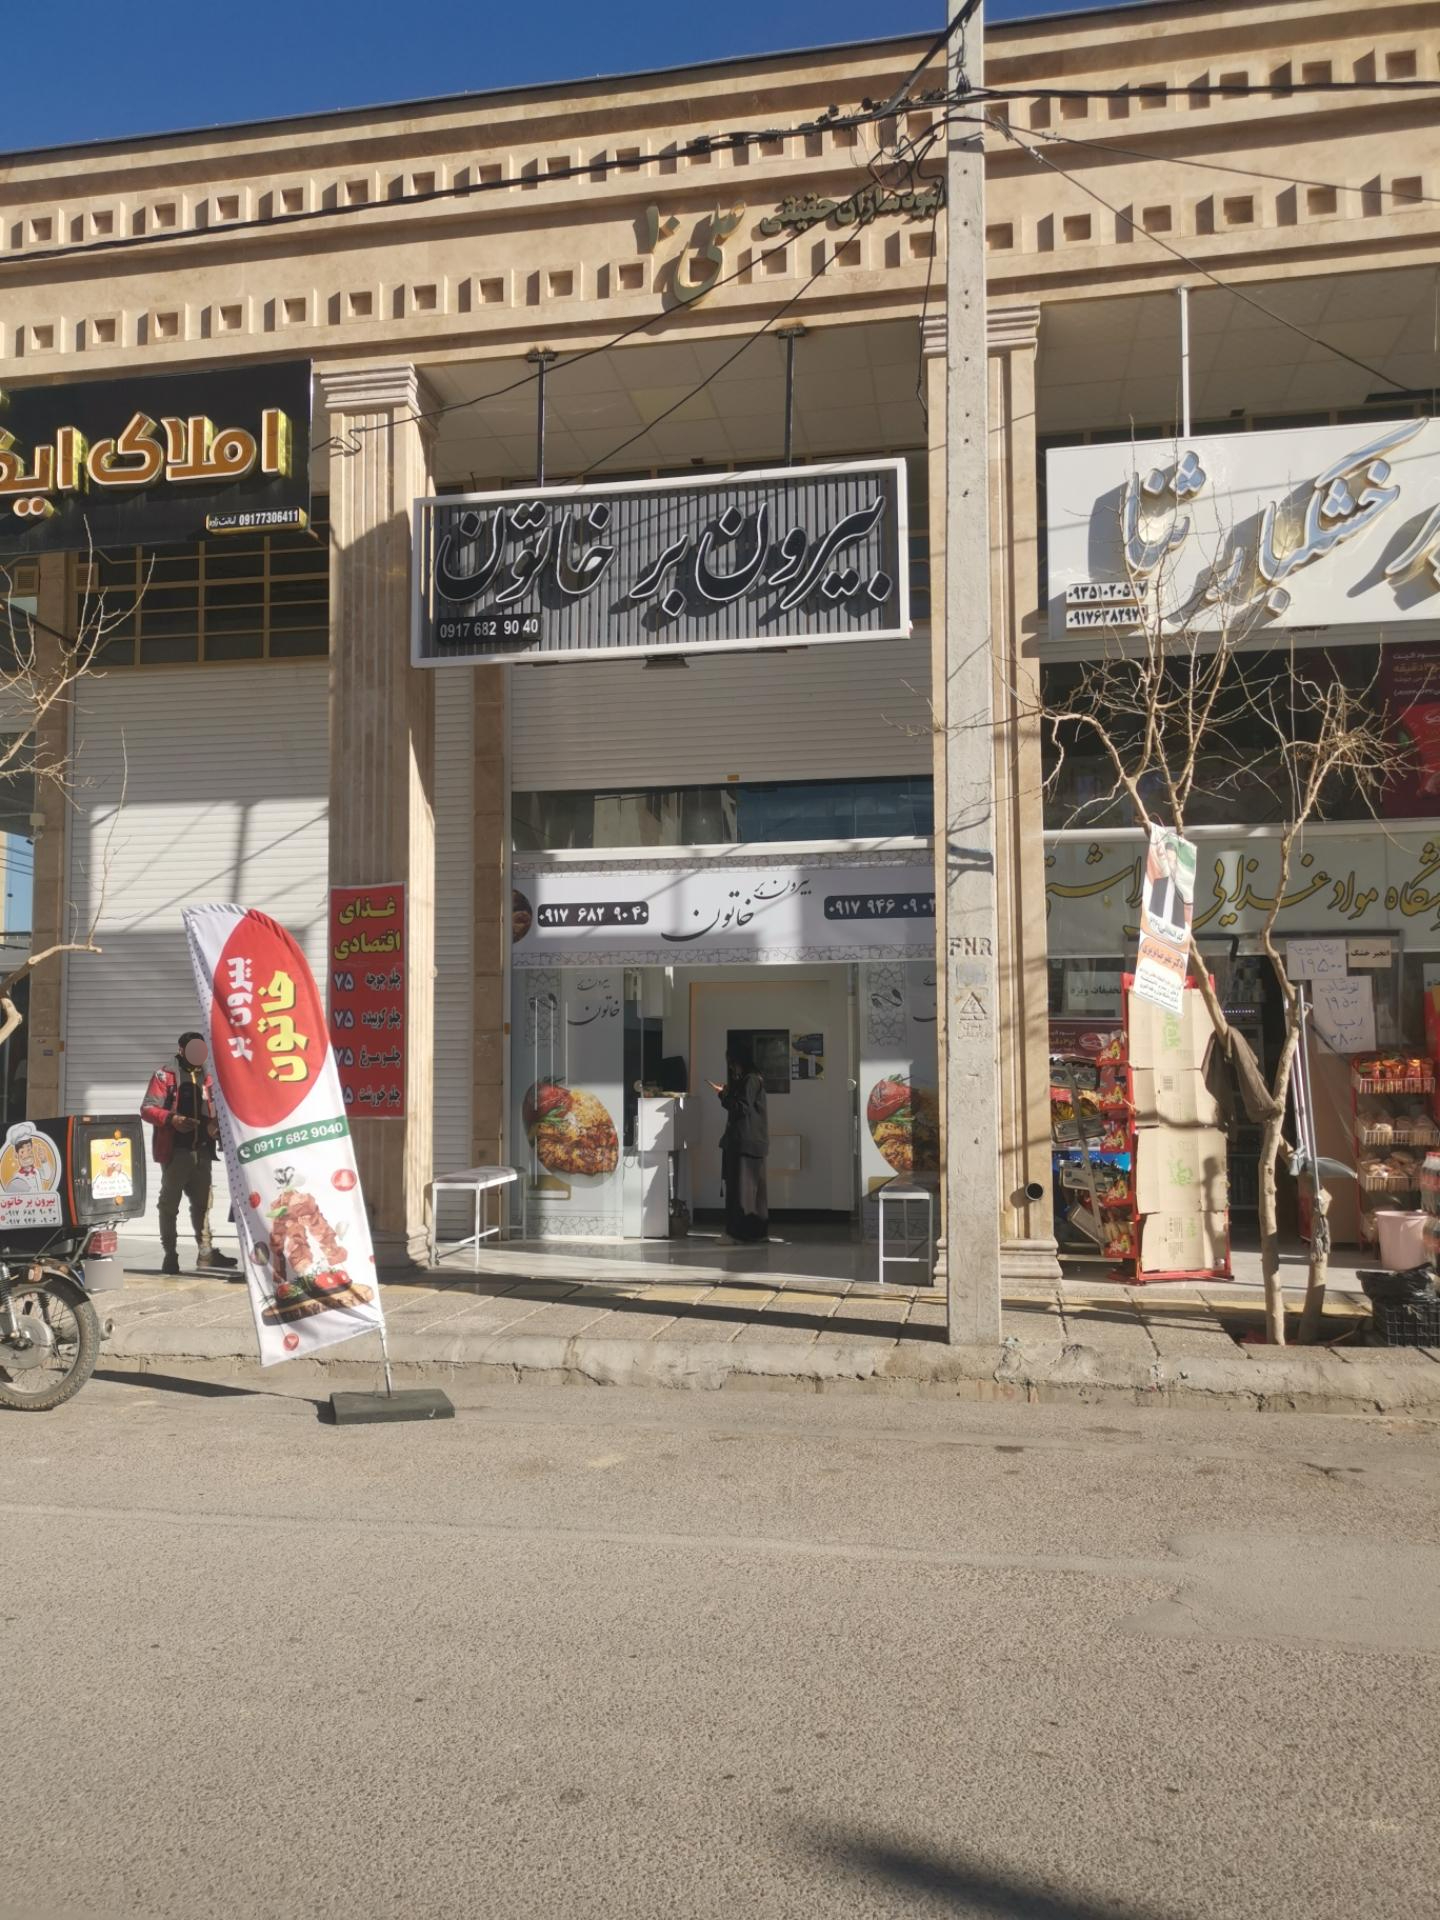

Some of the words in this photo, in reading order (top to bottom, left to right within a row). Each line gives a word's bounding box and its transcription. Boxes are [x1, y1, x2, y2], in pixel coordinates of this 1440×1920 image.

[87, 407, 288, 487] املاک
[239, 509, 299, 526] 09177306411
[435, 500, 618, 603] خاتون
[695, 495, 894, 610] بیرون
[629, 533, 690, 618] بر
[1068, 581, 1145, 600] ۰۹۳۵۱۰۲۰۵۷
[439, 622, 471, 639] 0917
[473, 620, 497, 637] 682
[503, 618, 520, 636] 90
[522, 617, 539, 634] 40
[338, 895, 396, 925] غذای
[828, 899, 861, 916] ۰۹۱۷
[867, 898, 895, 914] ۹۴۶
[1327, 870, 1379, 920] مواد
[539, 906, 568, 923] ۰۹۱۷
[577, 906, 605, 923] ۶۸۲
[614, 906, 628, 921] ۹۰
[632, 905, 648, 921] ۴۰
[660, 890, 755, 942] خاتون
[334, 928, 401, 960] اقتصادی
[227, 957, 253, 1027] بیرون
[334, 971, 355, 992] ۷۵
[257, 969, 308, 1082] خاتون
[334, 1008, 355, 1029] ۷۵
[227, 1036, 253, 1062] بر
[335, 1047, 354, 1067] ۷۵
[253, 1136, 283, 1154] 0917
[286, 1128, 309, 1145] 682
[311, 1122, 343, 1139] 9040
